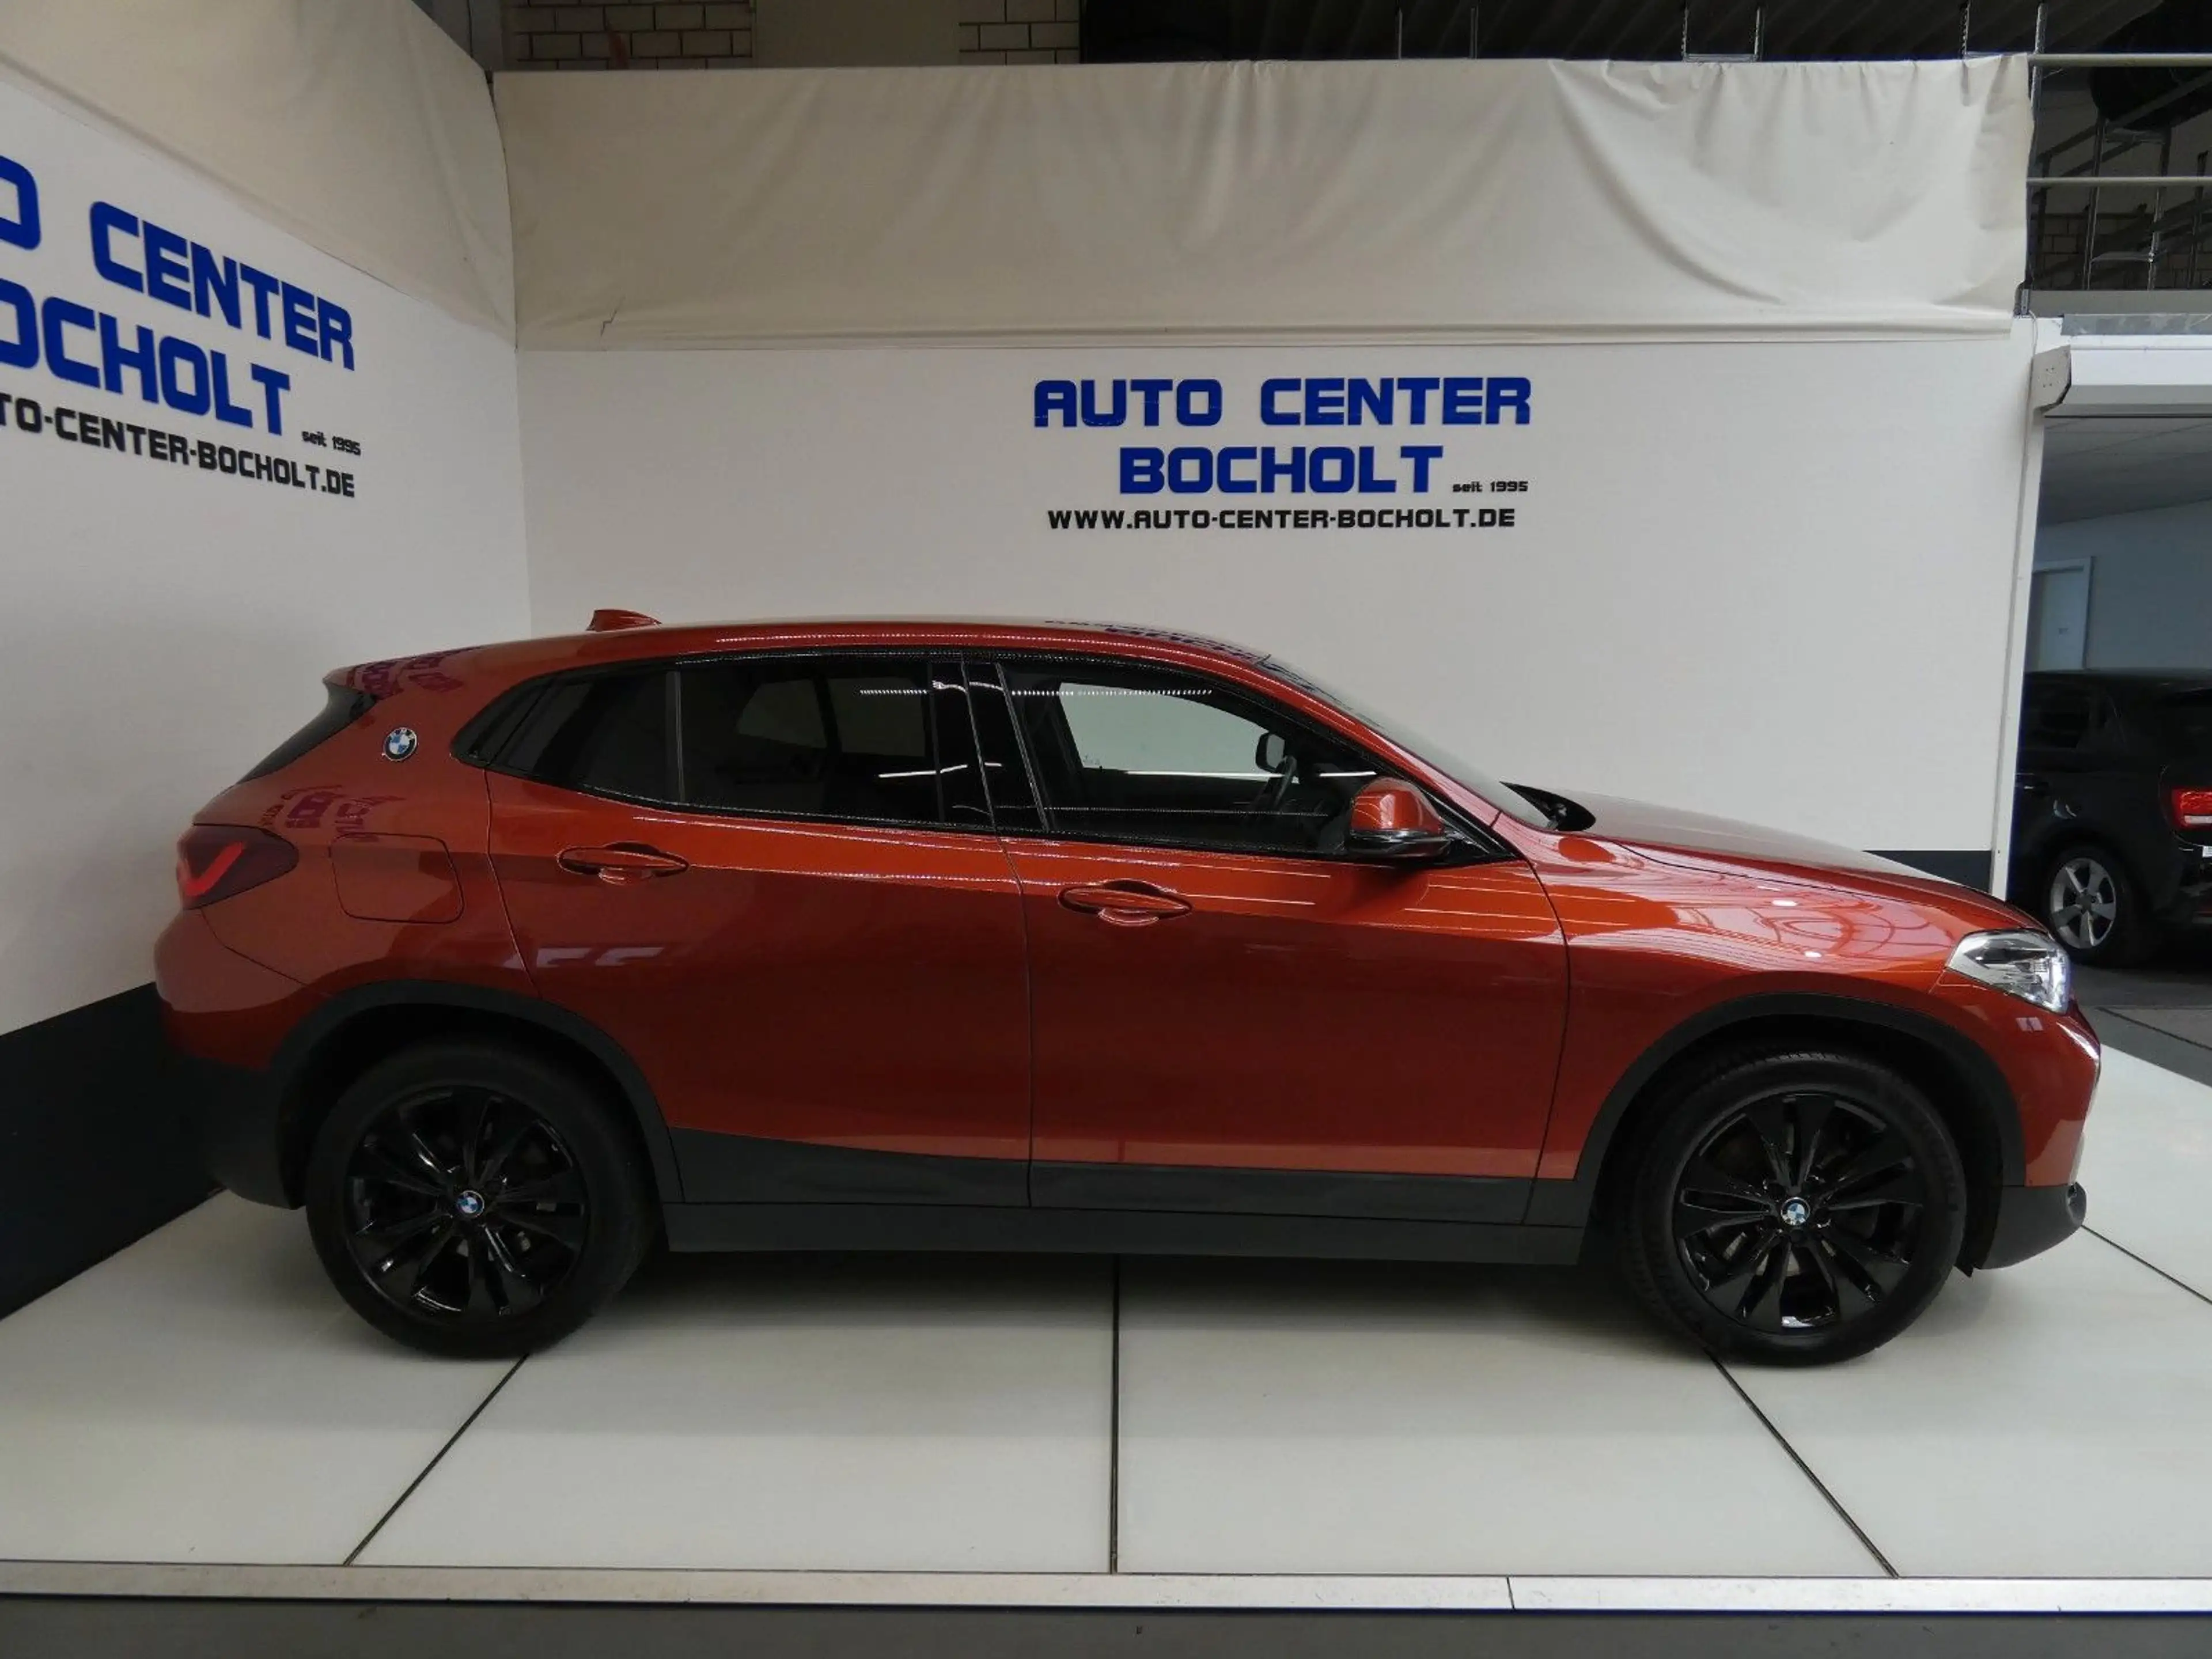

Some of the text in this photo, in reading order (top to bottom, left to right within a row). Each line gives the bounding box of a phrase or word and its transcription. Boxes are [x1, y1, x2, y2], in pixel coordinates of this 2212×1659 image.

[89, 201, 355, 372] CENTER
[1034, 377, 1531, 428] AUTO CENTER
[1119, 445, 1528, 494] BOCHOLT seit 1995
[1047, 508, 1515, 529] WWW.AUTO-CENTER-BOCHOLT.DE
